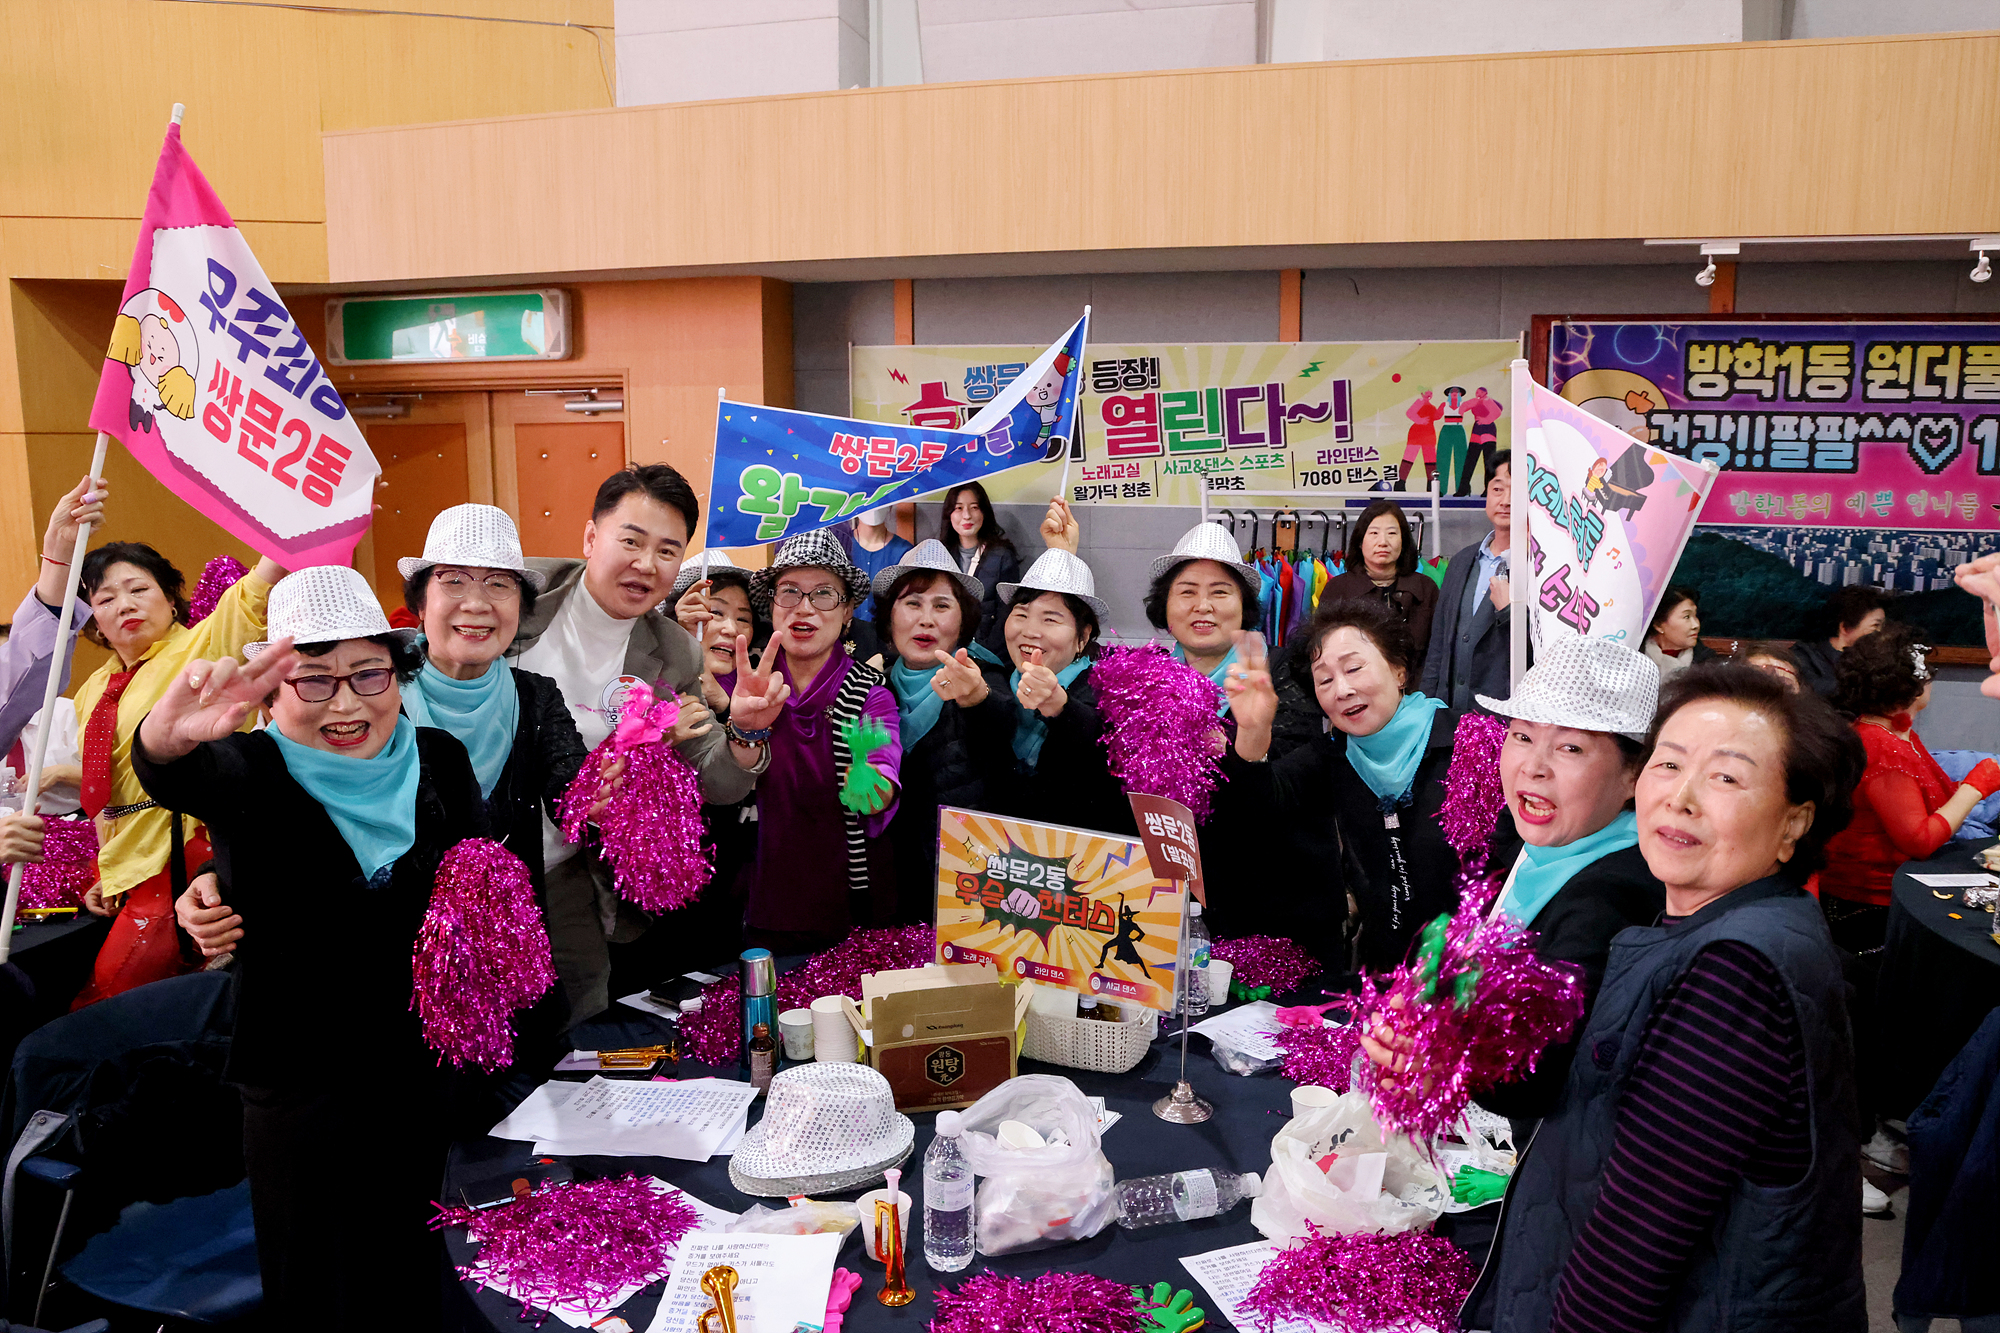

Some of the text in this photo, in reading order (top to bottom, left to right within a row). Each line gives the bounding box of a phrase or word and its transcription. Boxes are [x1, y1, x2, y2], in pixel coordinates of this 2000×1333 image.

[1092, 357, 1160, 393] 등장!
[1687, 340, 1852, 399] 방학1동
[1101, 379, 1353, 460] 열린다~!
[202, 358, 353, 508] 쌍문2동
[1163, 453, 1285, 475] 사교&댄스 스포츠
[1316, 446, 1380, 466] 라인댄스
[1081, 462, 1141, 481] 노래교실
[1299, 464, 1399, 487] 7080 댄스 걸
[1073, 482, 1151, 501] 왈가닥 청춘
[1729, 489, 1980, 520] 방학1동의 예쁜 언니들
[1144, 812, 1197, 854] 쌍문2동
[986, 855, 1067, 891] 쌍문2동
[955, 873, 1116, 934] 우승 헌터스
[962, 951, 977, 962] 노래
[1034, 966, 1066, 980] 라인 댄스
[1105, 982, 1137, 996] 사교 댄스
[930, 1057, 960, 1074] 원탕
